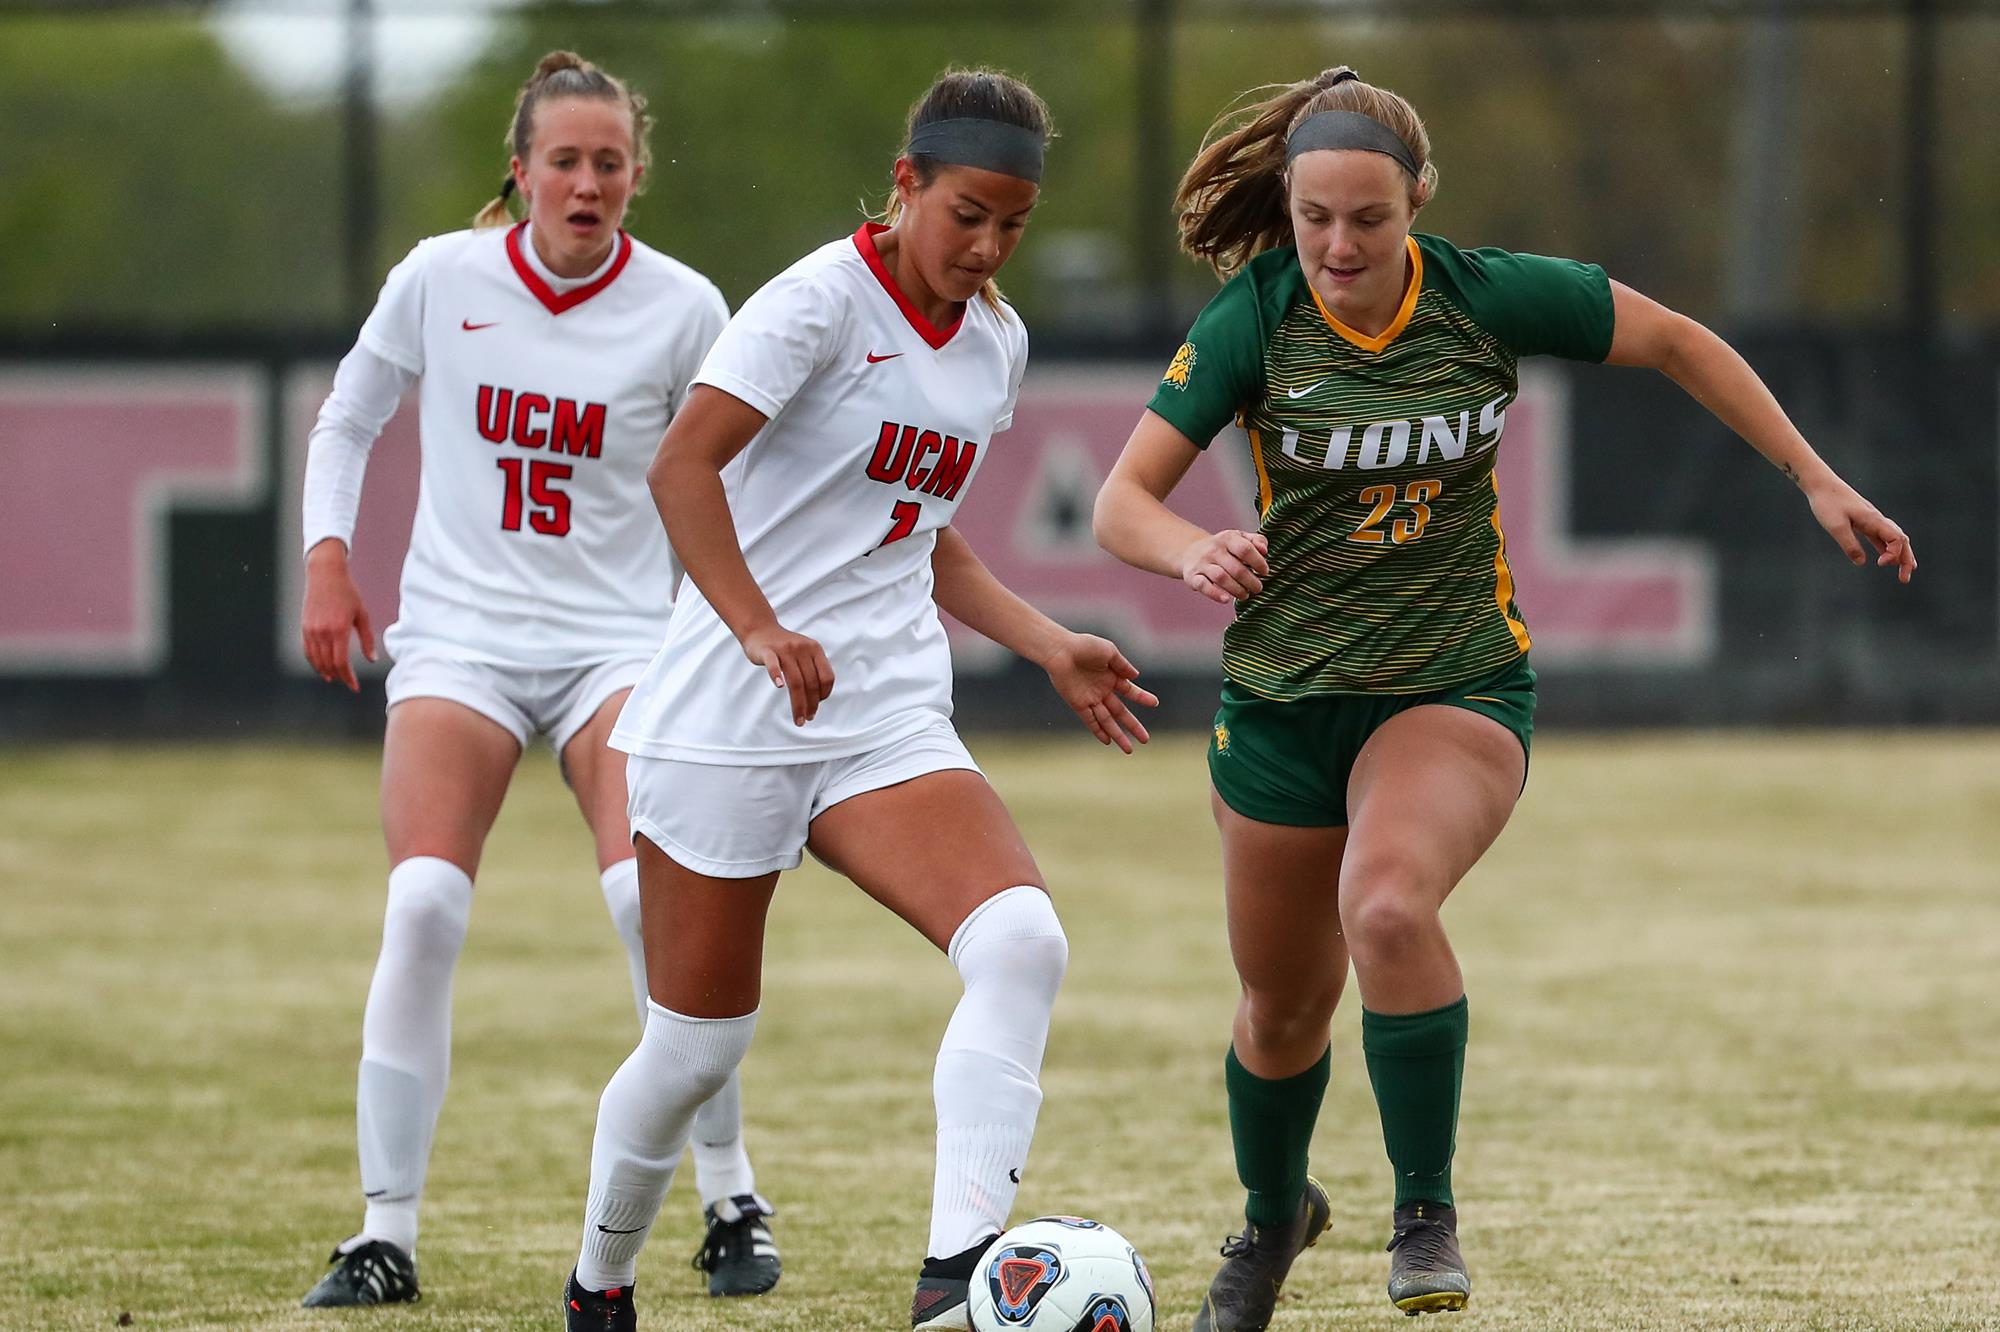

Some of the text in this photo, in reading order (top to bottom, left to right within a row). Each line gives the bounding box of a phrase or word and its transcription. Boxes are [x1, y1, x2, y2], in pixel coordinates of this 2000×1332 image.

[476, 384, 607, 460] UCM
[1281, 392, 1508, 470] LIONS
[496, 457, 573, 537] 15
[865, 421, 977, 502] UCM
[1346, 479, 1442, 545] 23
